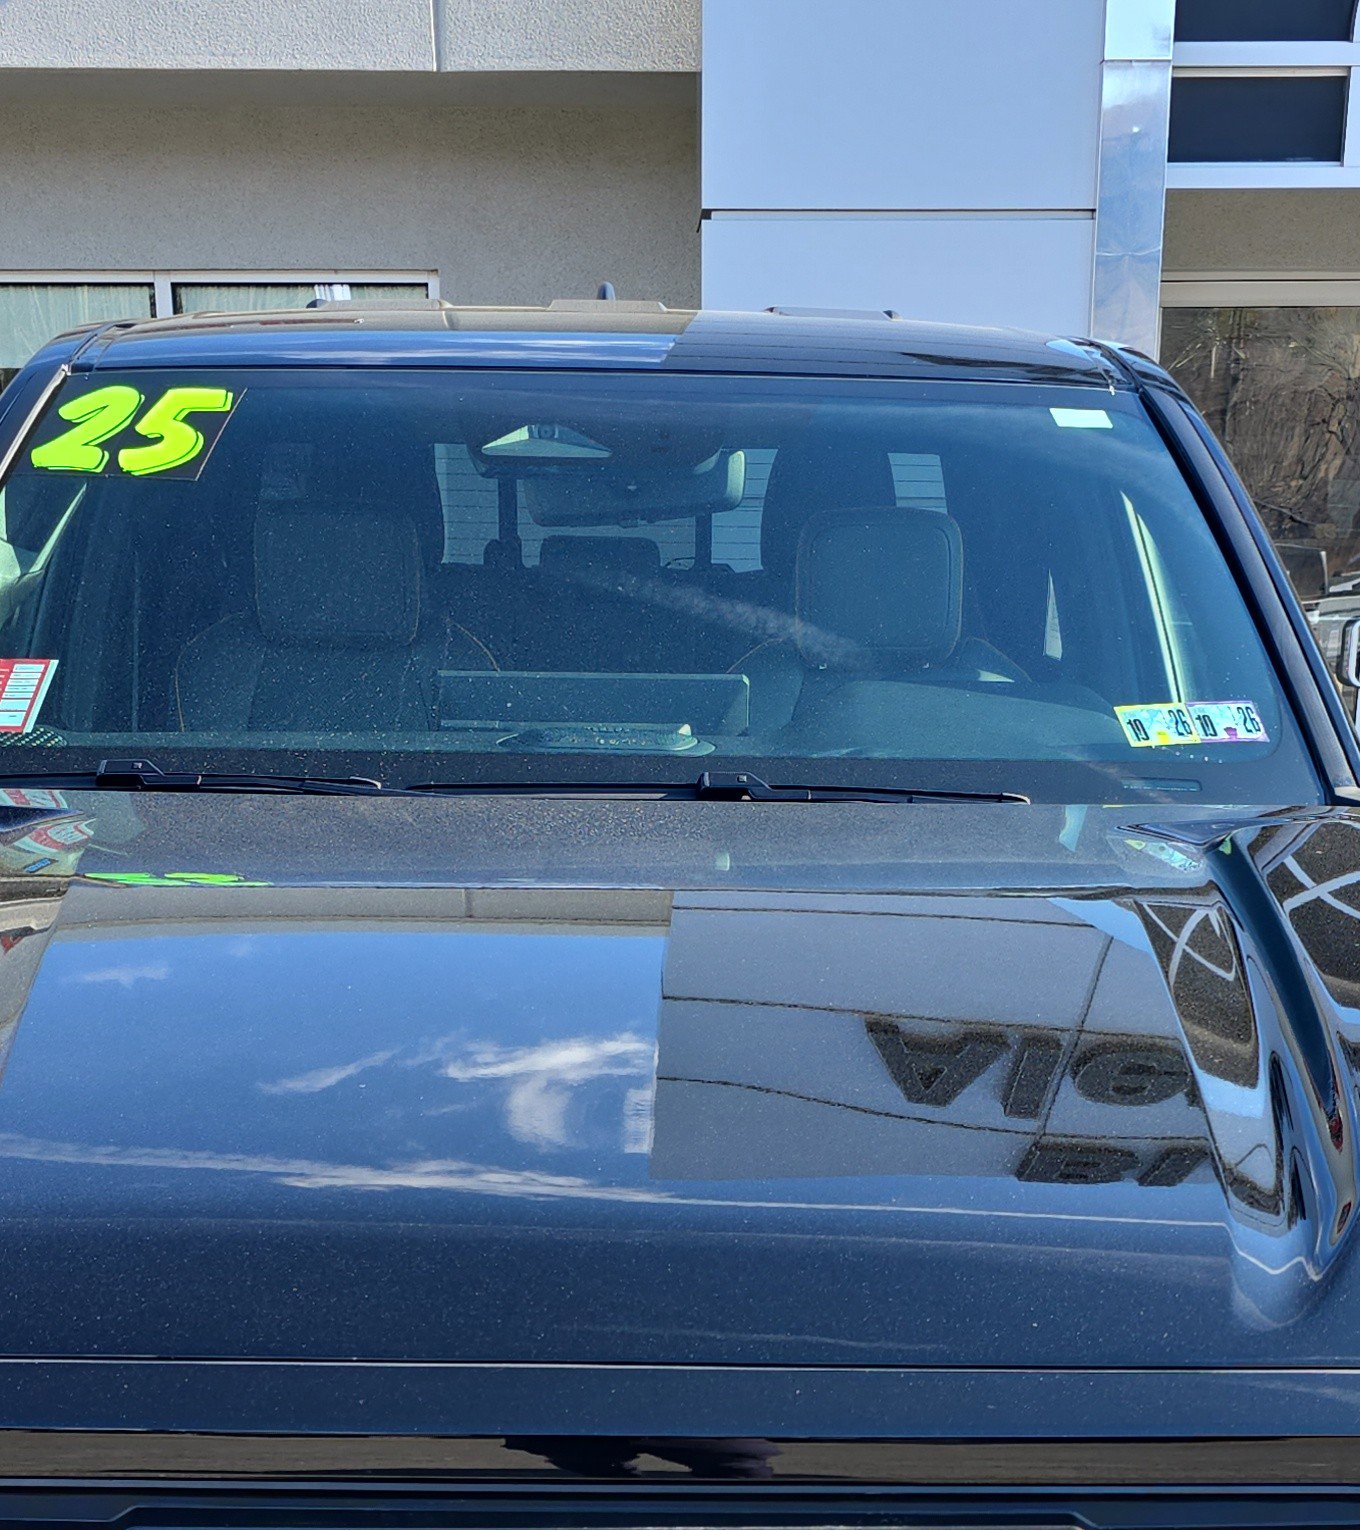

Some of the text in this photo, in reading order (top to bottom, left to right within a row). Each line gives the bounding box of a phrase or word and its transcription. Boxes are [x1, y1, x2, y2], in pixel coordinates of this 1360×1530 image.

[30, 384, 233, 477] 25
[1168, 709, 1193, 737] 26
[1237, 706, 1261, 734] 26
